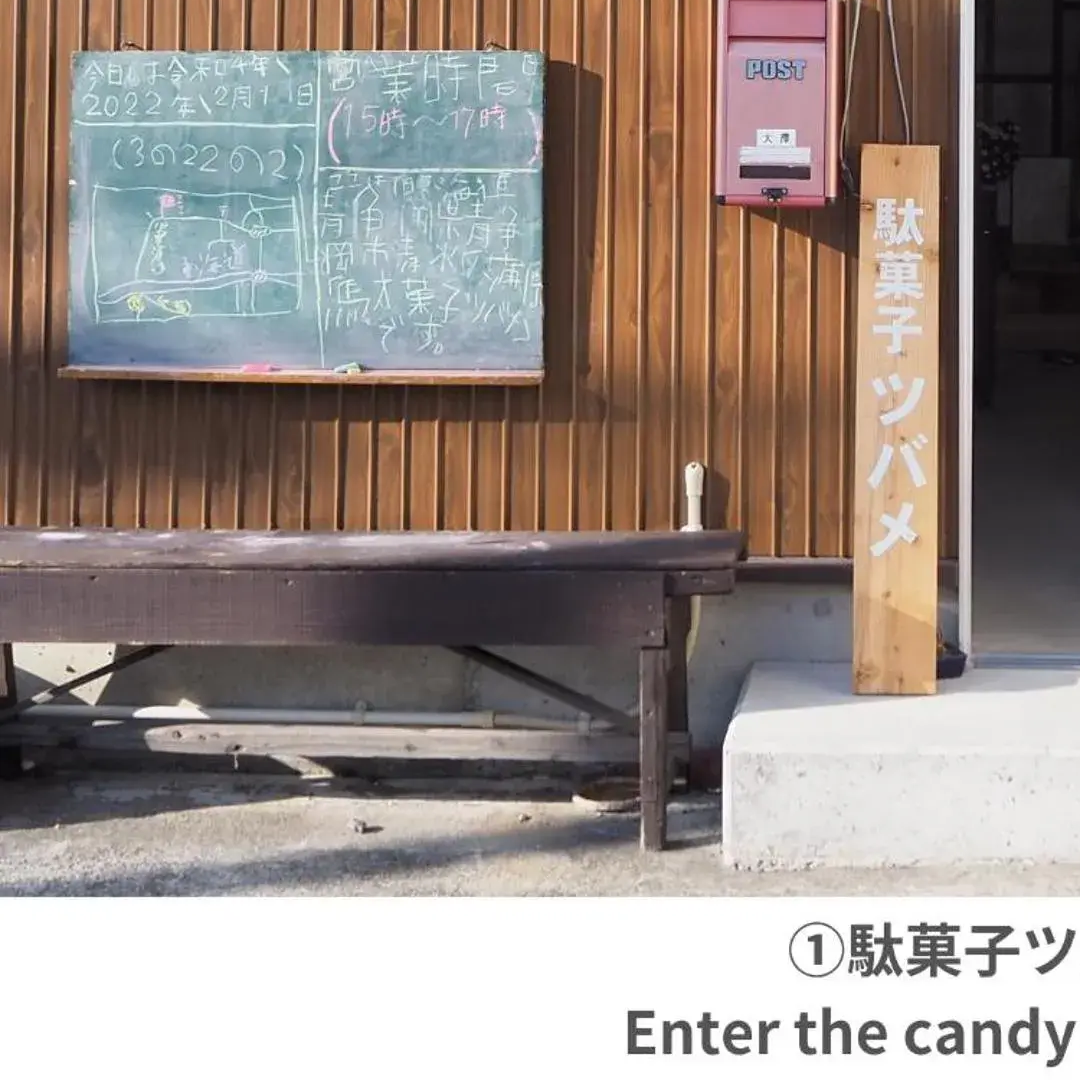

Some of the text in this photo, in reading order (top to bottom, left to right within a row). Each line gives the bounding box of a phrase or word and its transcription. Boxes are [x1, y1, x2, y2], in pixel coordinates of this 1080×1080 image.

[746, 58, 807, 81] POST
[866, 197, 930, 558] 駄菓子ツバメ
